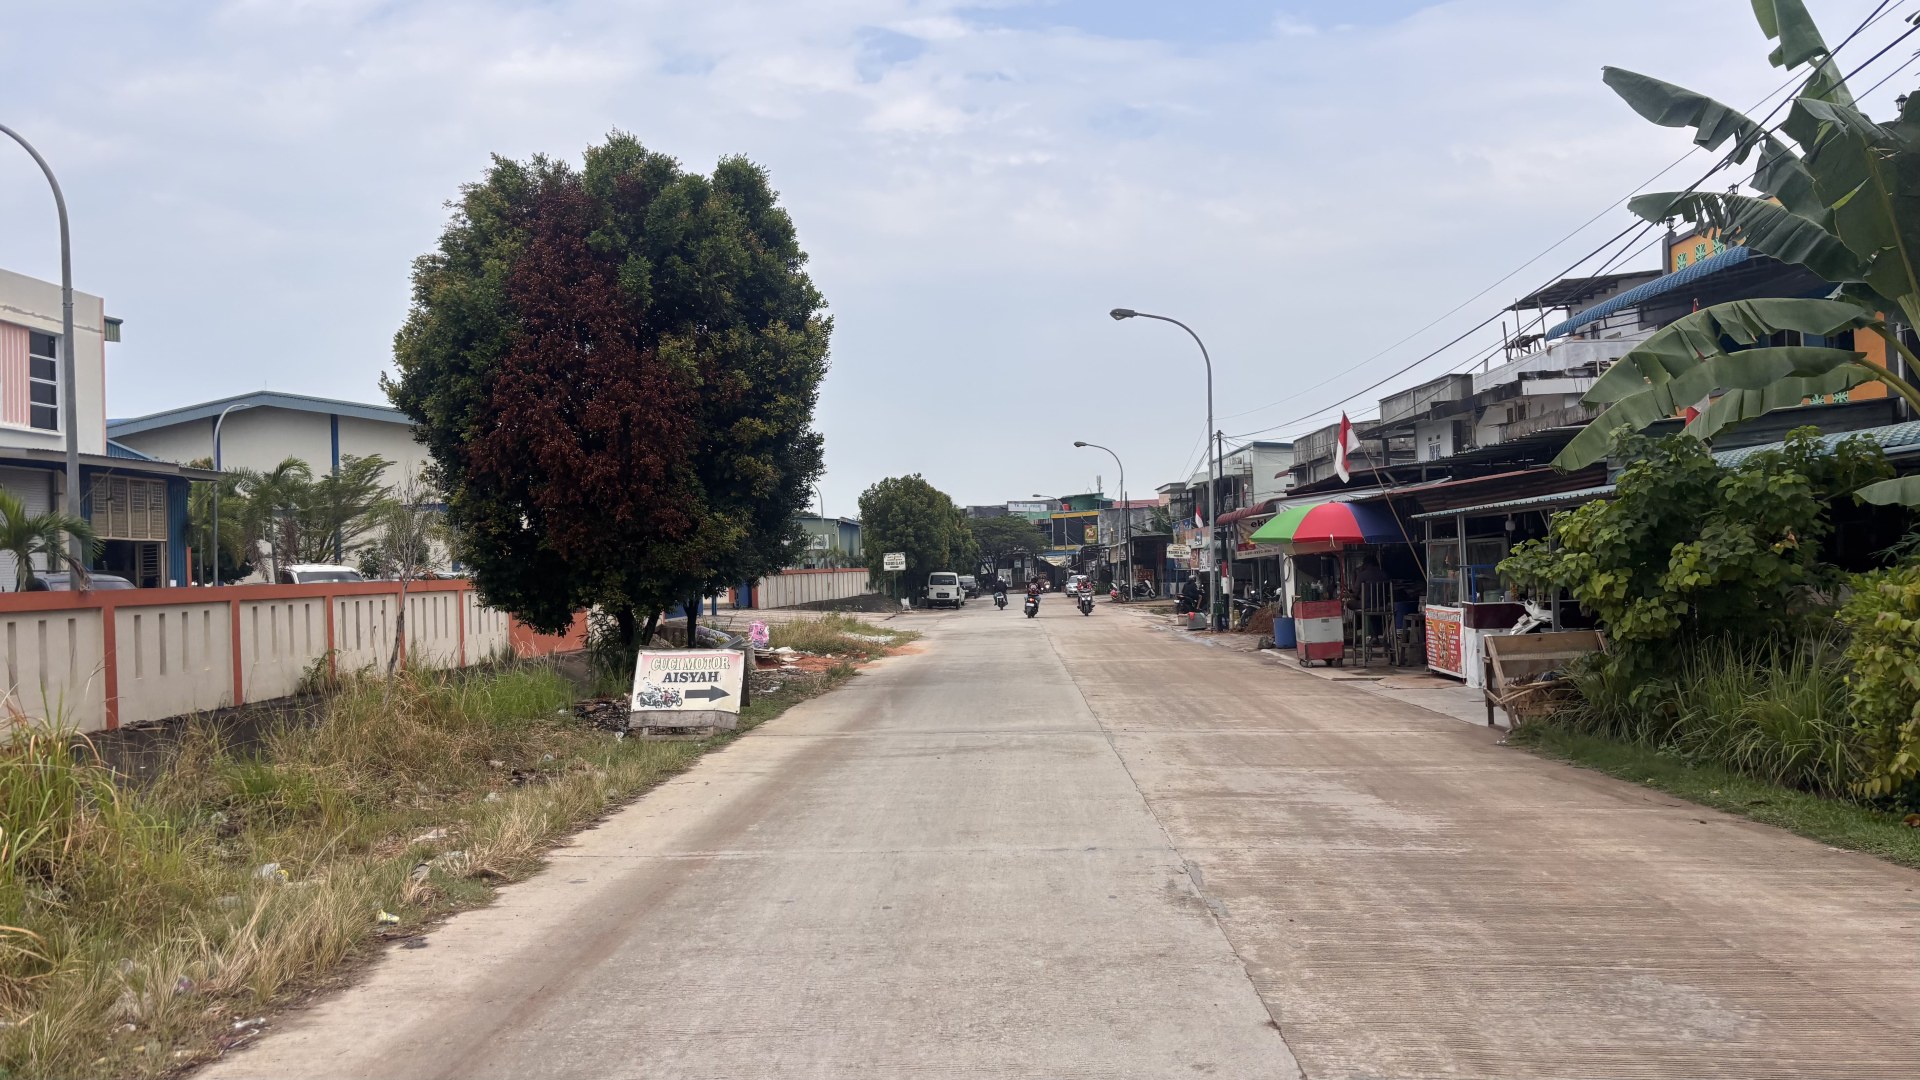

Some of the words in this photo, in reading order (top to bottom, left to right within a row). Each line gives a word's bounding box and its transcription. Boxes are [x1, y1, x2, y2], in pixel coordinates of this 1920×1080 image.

[651, 657, 681, 671] CUCI
[682, 656, 730, 671] MOTOR
[662, 671, 720, 683] AISYAH
